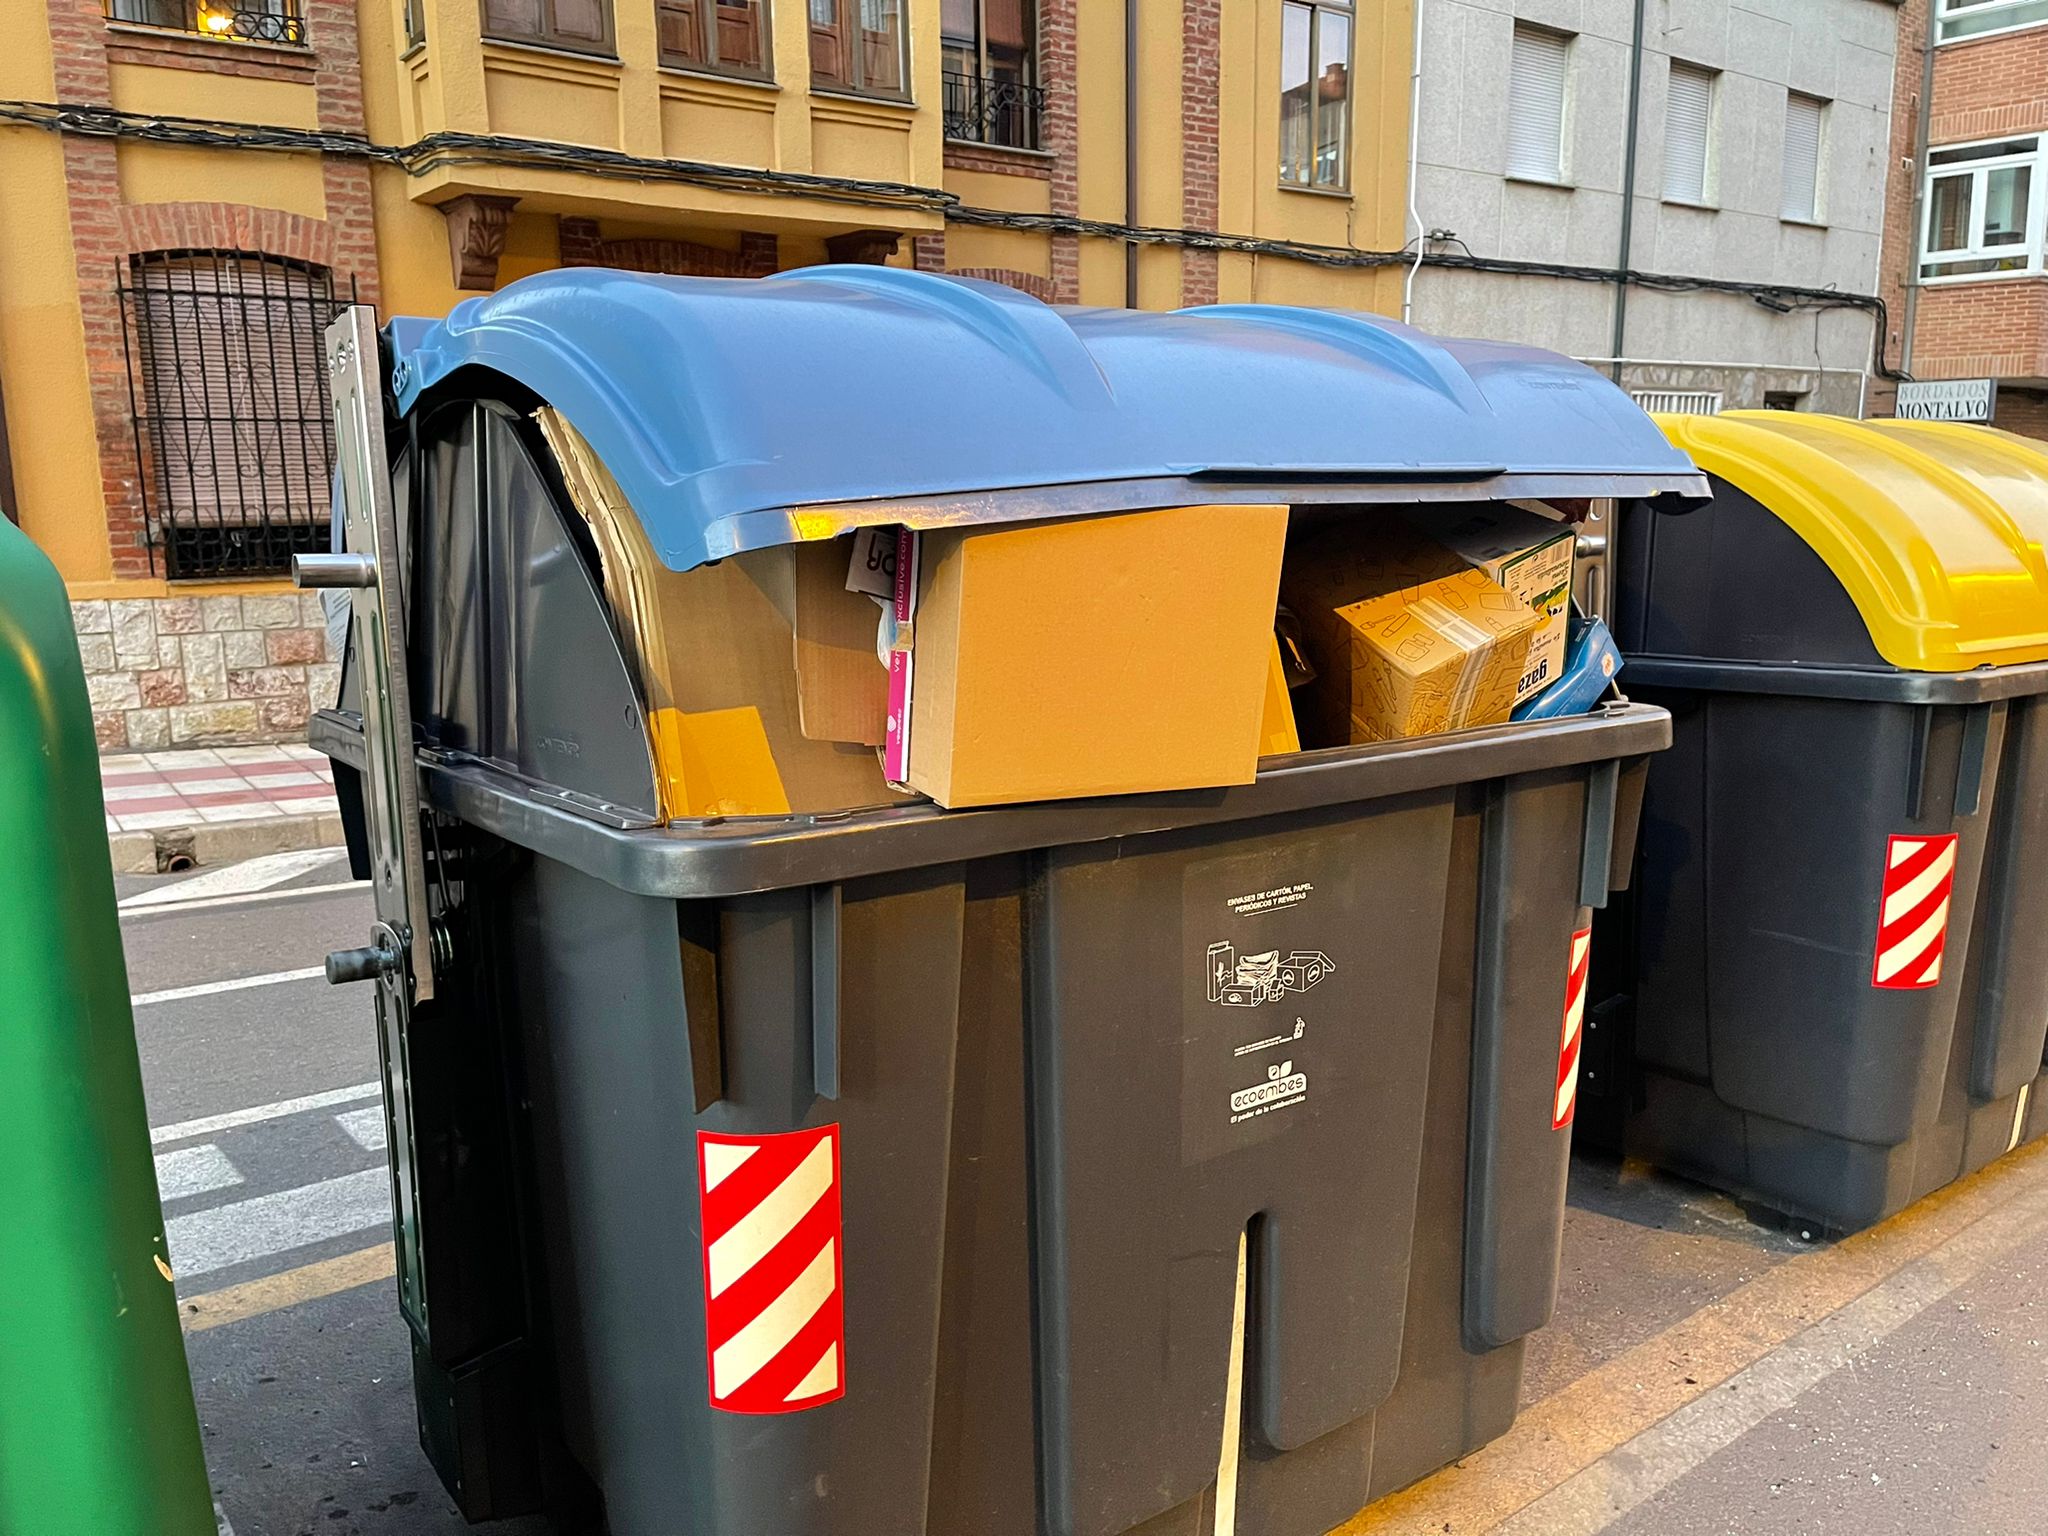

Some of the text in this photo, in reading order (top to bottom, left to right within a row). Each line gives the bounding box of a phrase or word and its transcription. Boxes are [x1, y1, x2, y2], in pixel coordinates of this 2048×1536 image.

[1899, 381, 1989, 400] BORDADOS
[1898, 399, 1987, 419] MONTALVO
[1517, 658, 1548, 694] gaza
[1227, 894, 1256, 906] ENVASES
[1256, 892, 1266, 900] DE
[1235, 899, 1273, 913] PERIÓDICOS
[1278, 892, 1307, 904] REVISTAS
[1234, 1077, 1304, 1107] ecoembes
